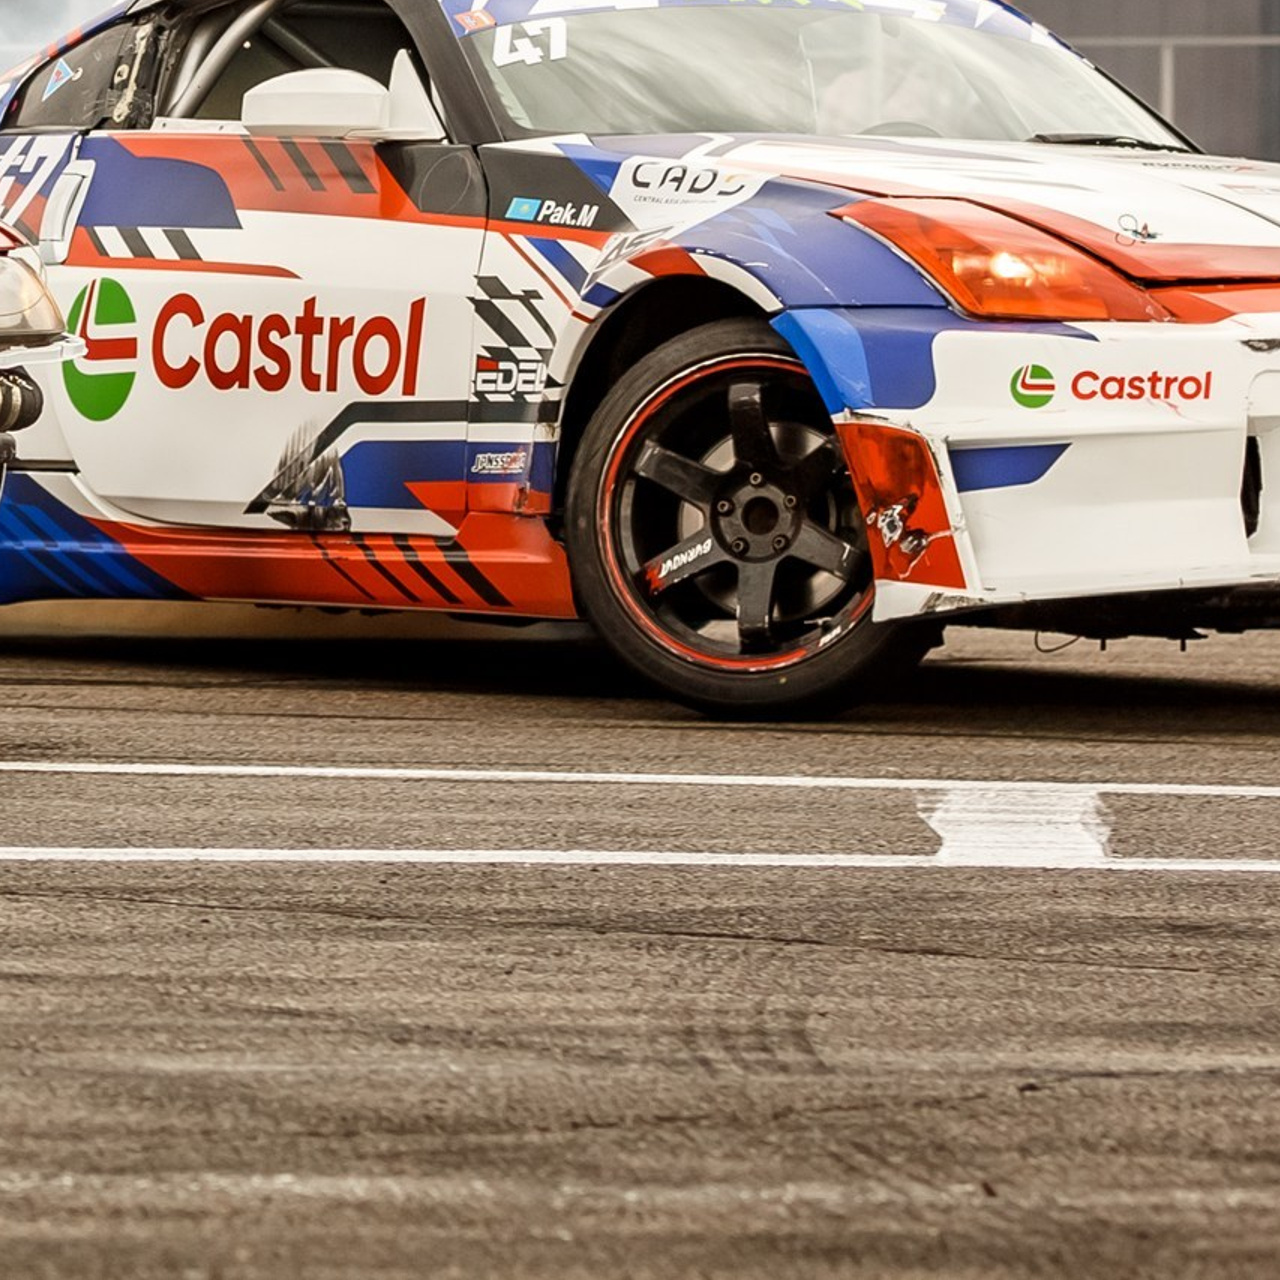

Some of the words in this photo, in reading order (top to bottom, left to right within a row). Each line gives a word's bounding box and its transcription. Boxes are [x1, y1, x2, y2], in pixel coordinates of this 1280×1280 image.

[492, 17, 568, 67] 47
[537, 199, 599, 228] Pak.M
[152, 293, 427, 397] Castrol
[1071, 370, 1212, 401] Castrol
